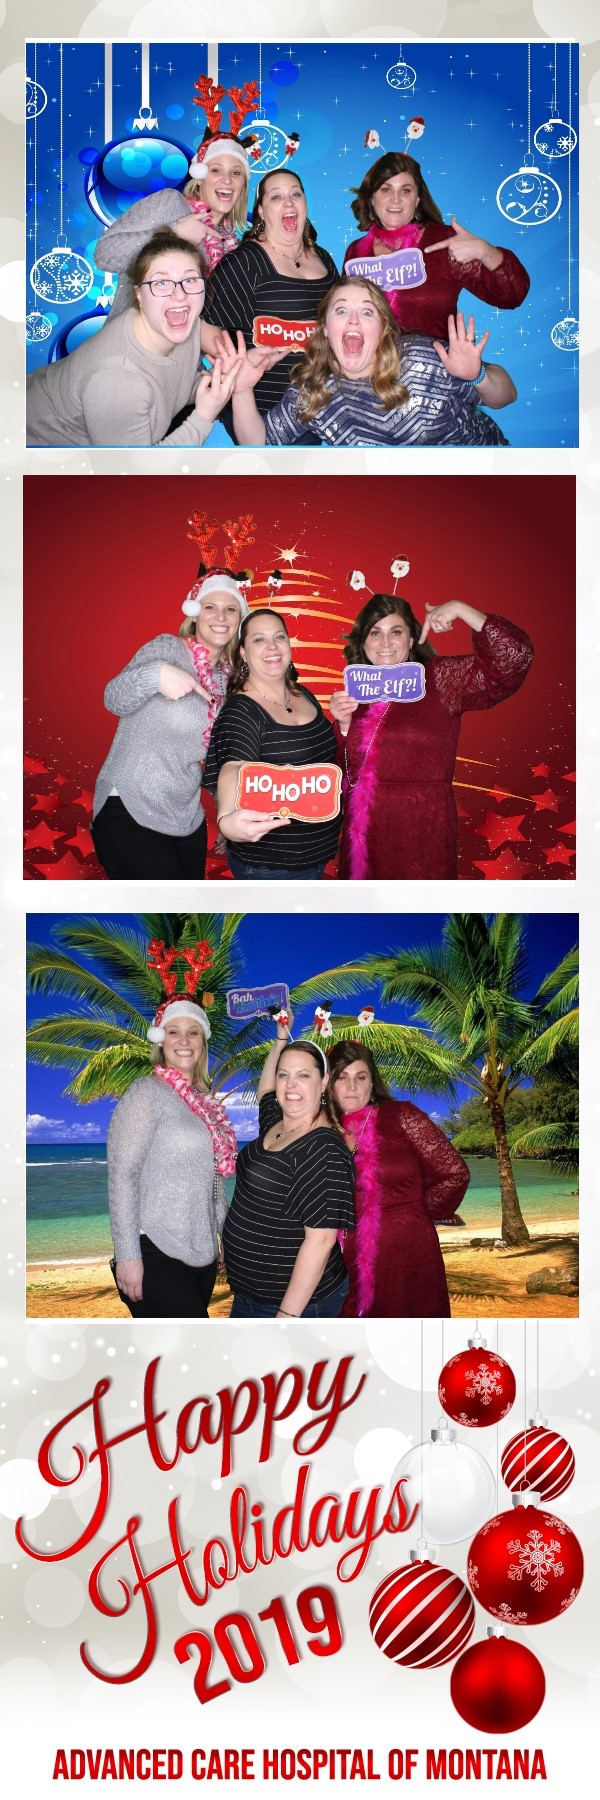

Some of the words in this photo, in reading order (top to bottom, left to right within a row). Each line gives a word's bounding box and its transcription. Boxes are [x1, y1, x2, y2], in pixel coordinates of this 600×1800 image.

[352, 262, 382, 275] What
[386, 263, 417, 285] Elf?!
[260, 324, 282, 335] HO
[283, 329, 306, 341] HO
[350, 671, 382, 682] What
[356, 684, 380, 697] The
[384, 678, 417, 698] Elf?!
[245, 775, 272, 793] HO
[271, 783, 300, 802] HO
[301, 774, 332, 794] HO
[231, 992, 255, 1004] Bah
